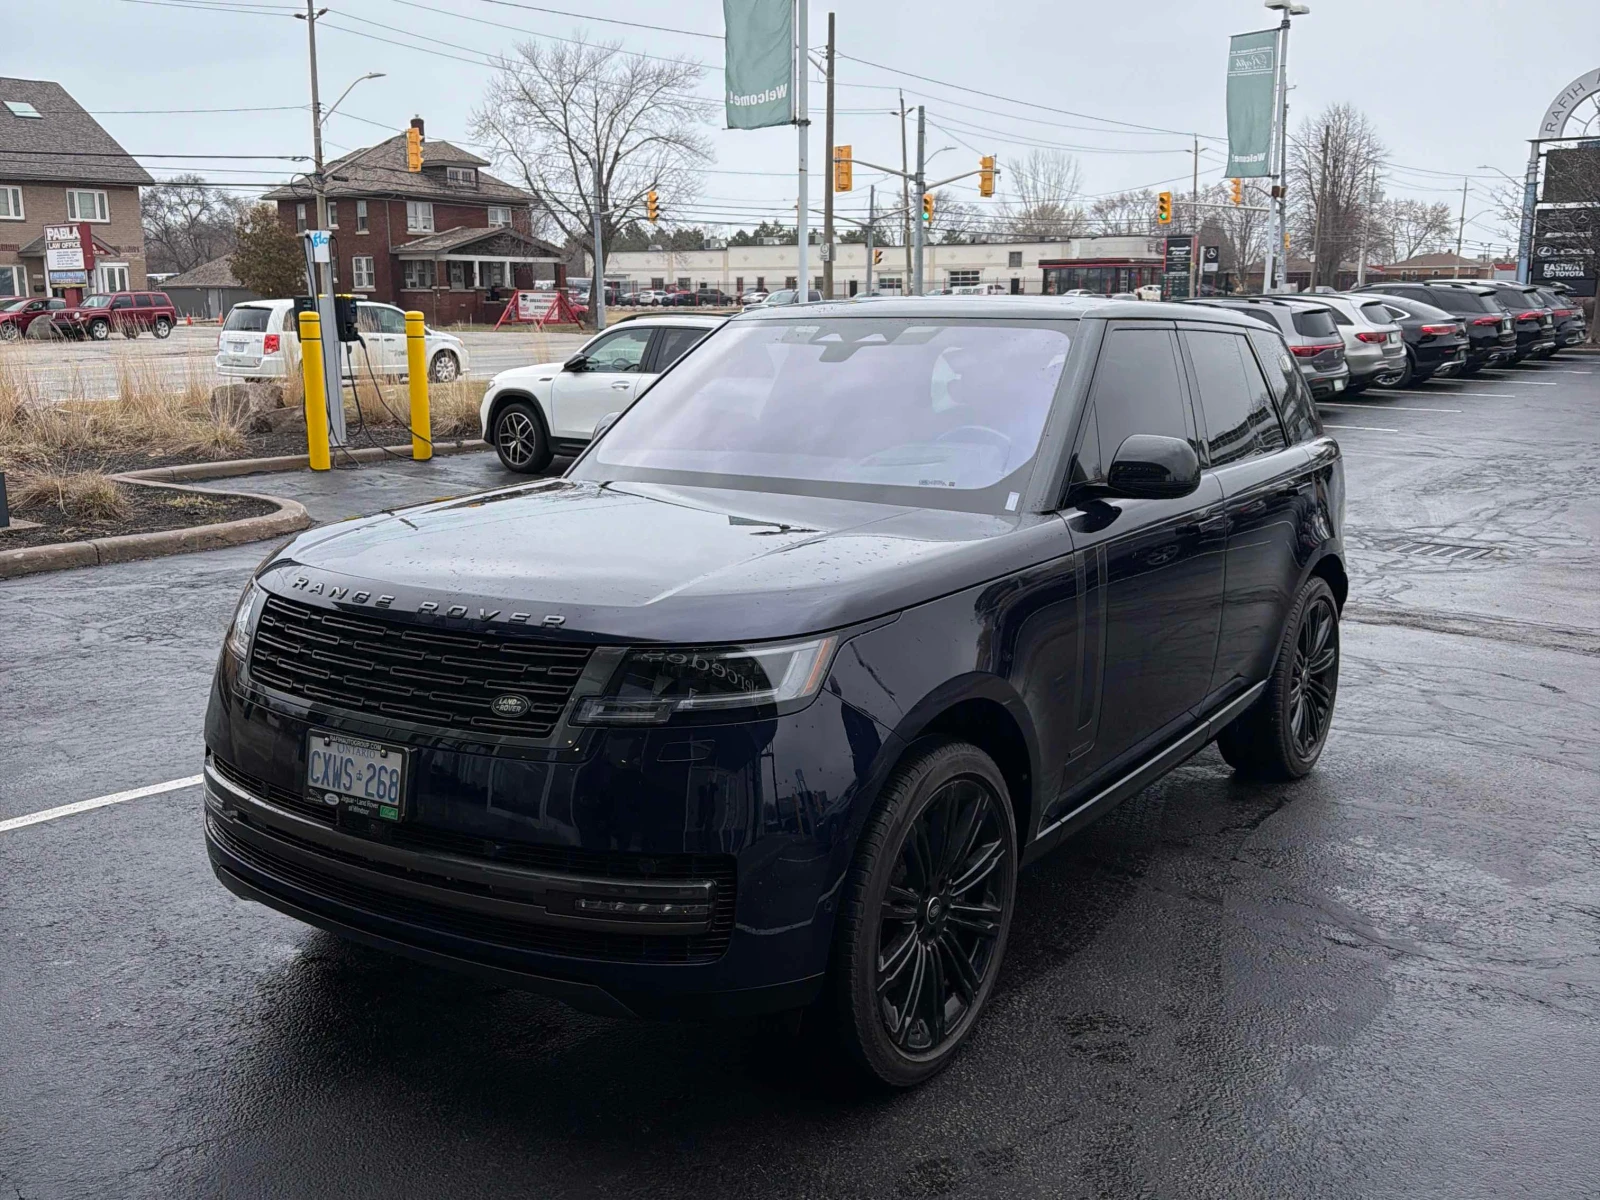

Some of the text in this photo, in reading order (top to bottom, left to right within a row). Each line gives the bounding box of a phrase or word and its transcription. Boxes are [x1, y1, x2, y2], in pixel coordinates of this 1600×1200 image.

[1545, 83, 1586, 132] RAFIH
[46, 226, 80, 241] PABLA
[313, 231, 329, 247] flo
[291, 576, 566, 629] RANGE ROVER
[337, 743, 376, 759] ONTARIO
[310, 750, 400, 803] CXWS 268
